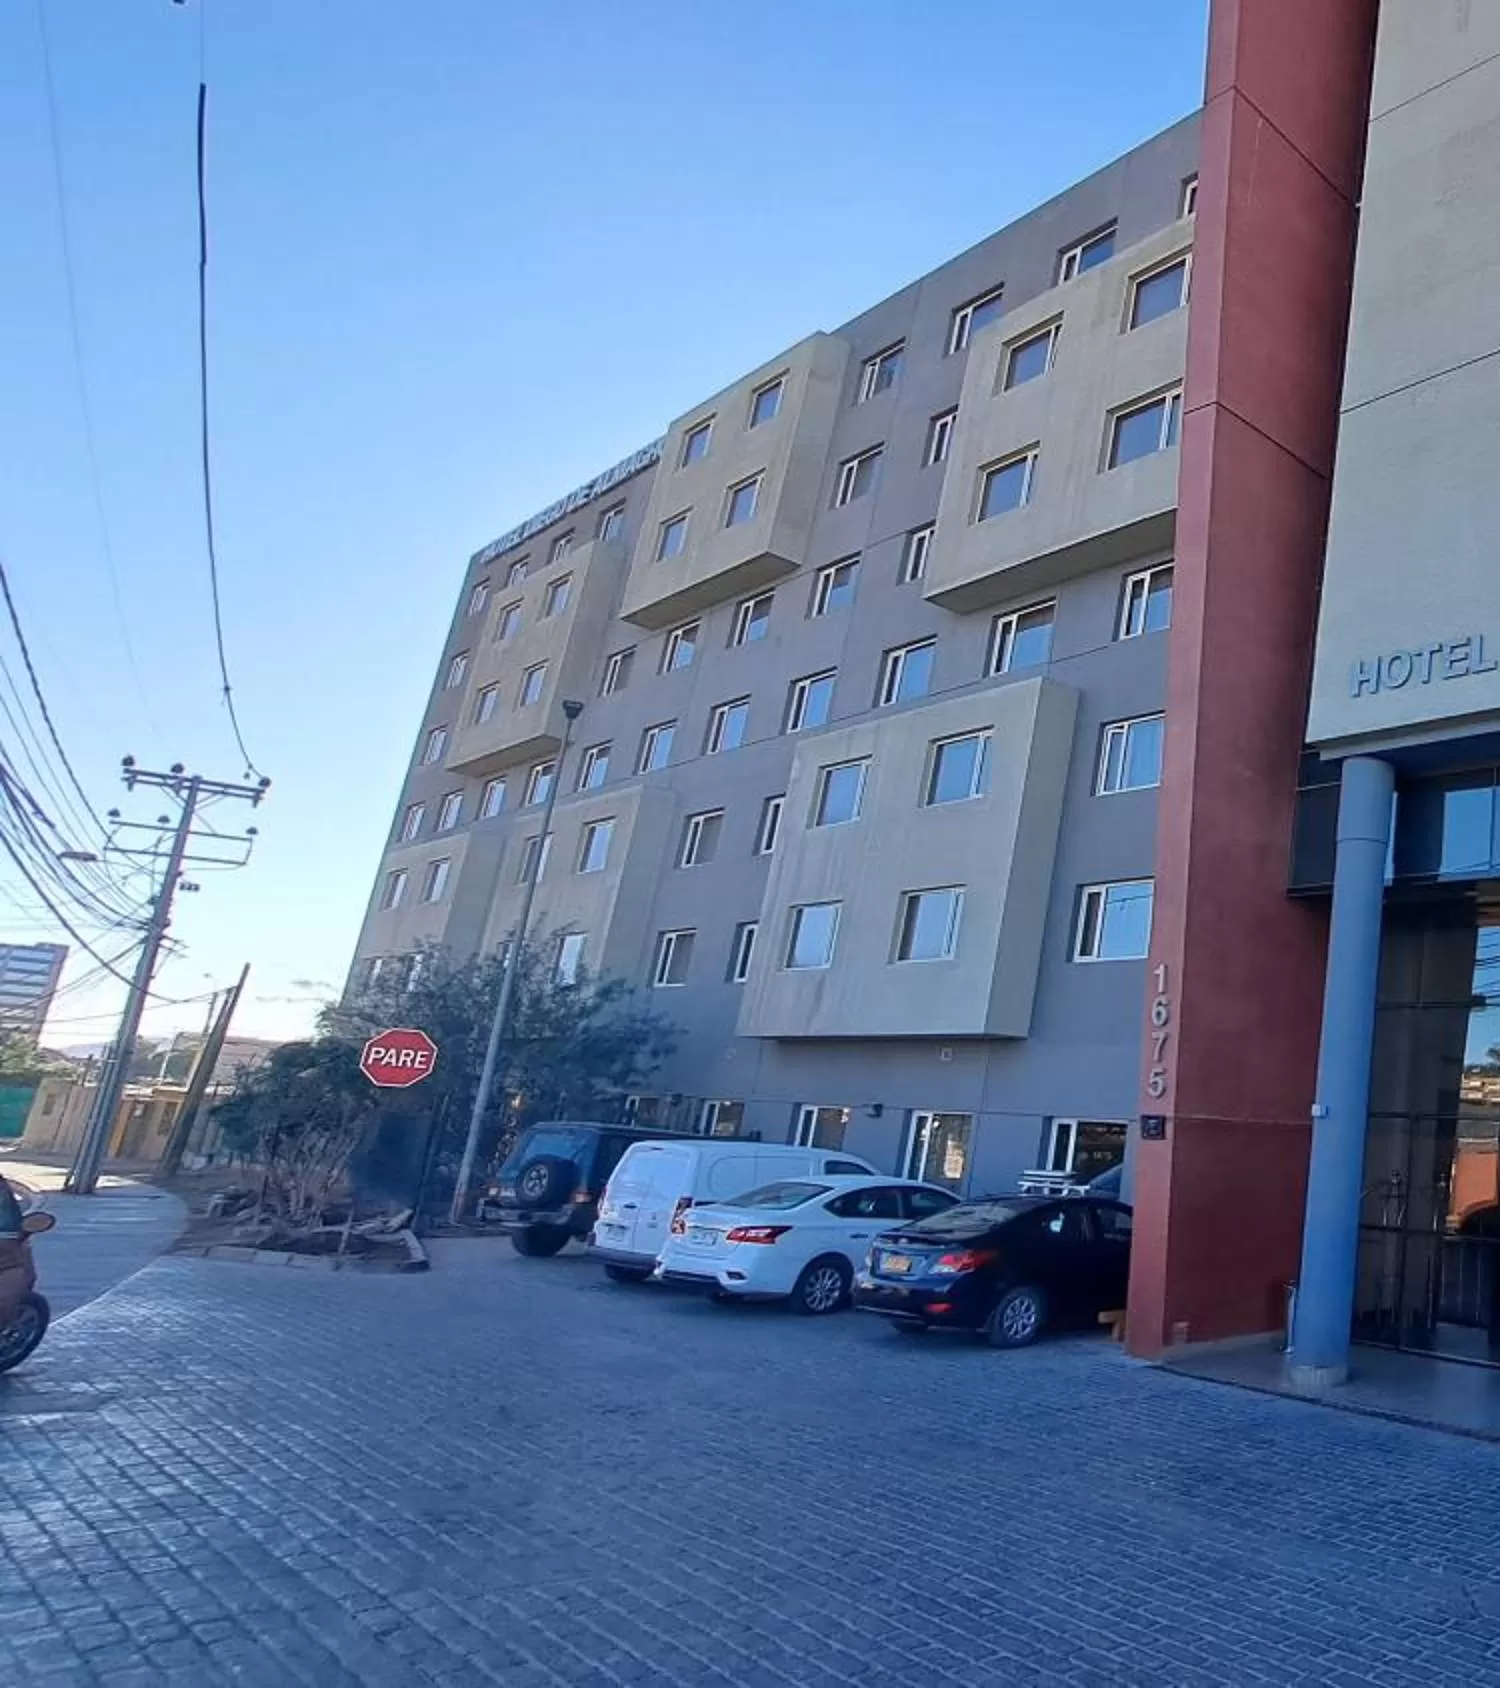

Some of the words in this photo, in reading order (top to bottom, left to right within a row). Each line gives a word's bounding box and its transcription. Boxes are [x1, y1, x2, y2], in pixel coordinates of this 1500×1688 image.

[1349, 634, 1497, 697] HOTEL
[368, 1047, 429, 1069] PARE
[1149, 963, 1170, 1098] 1675
